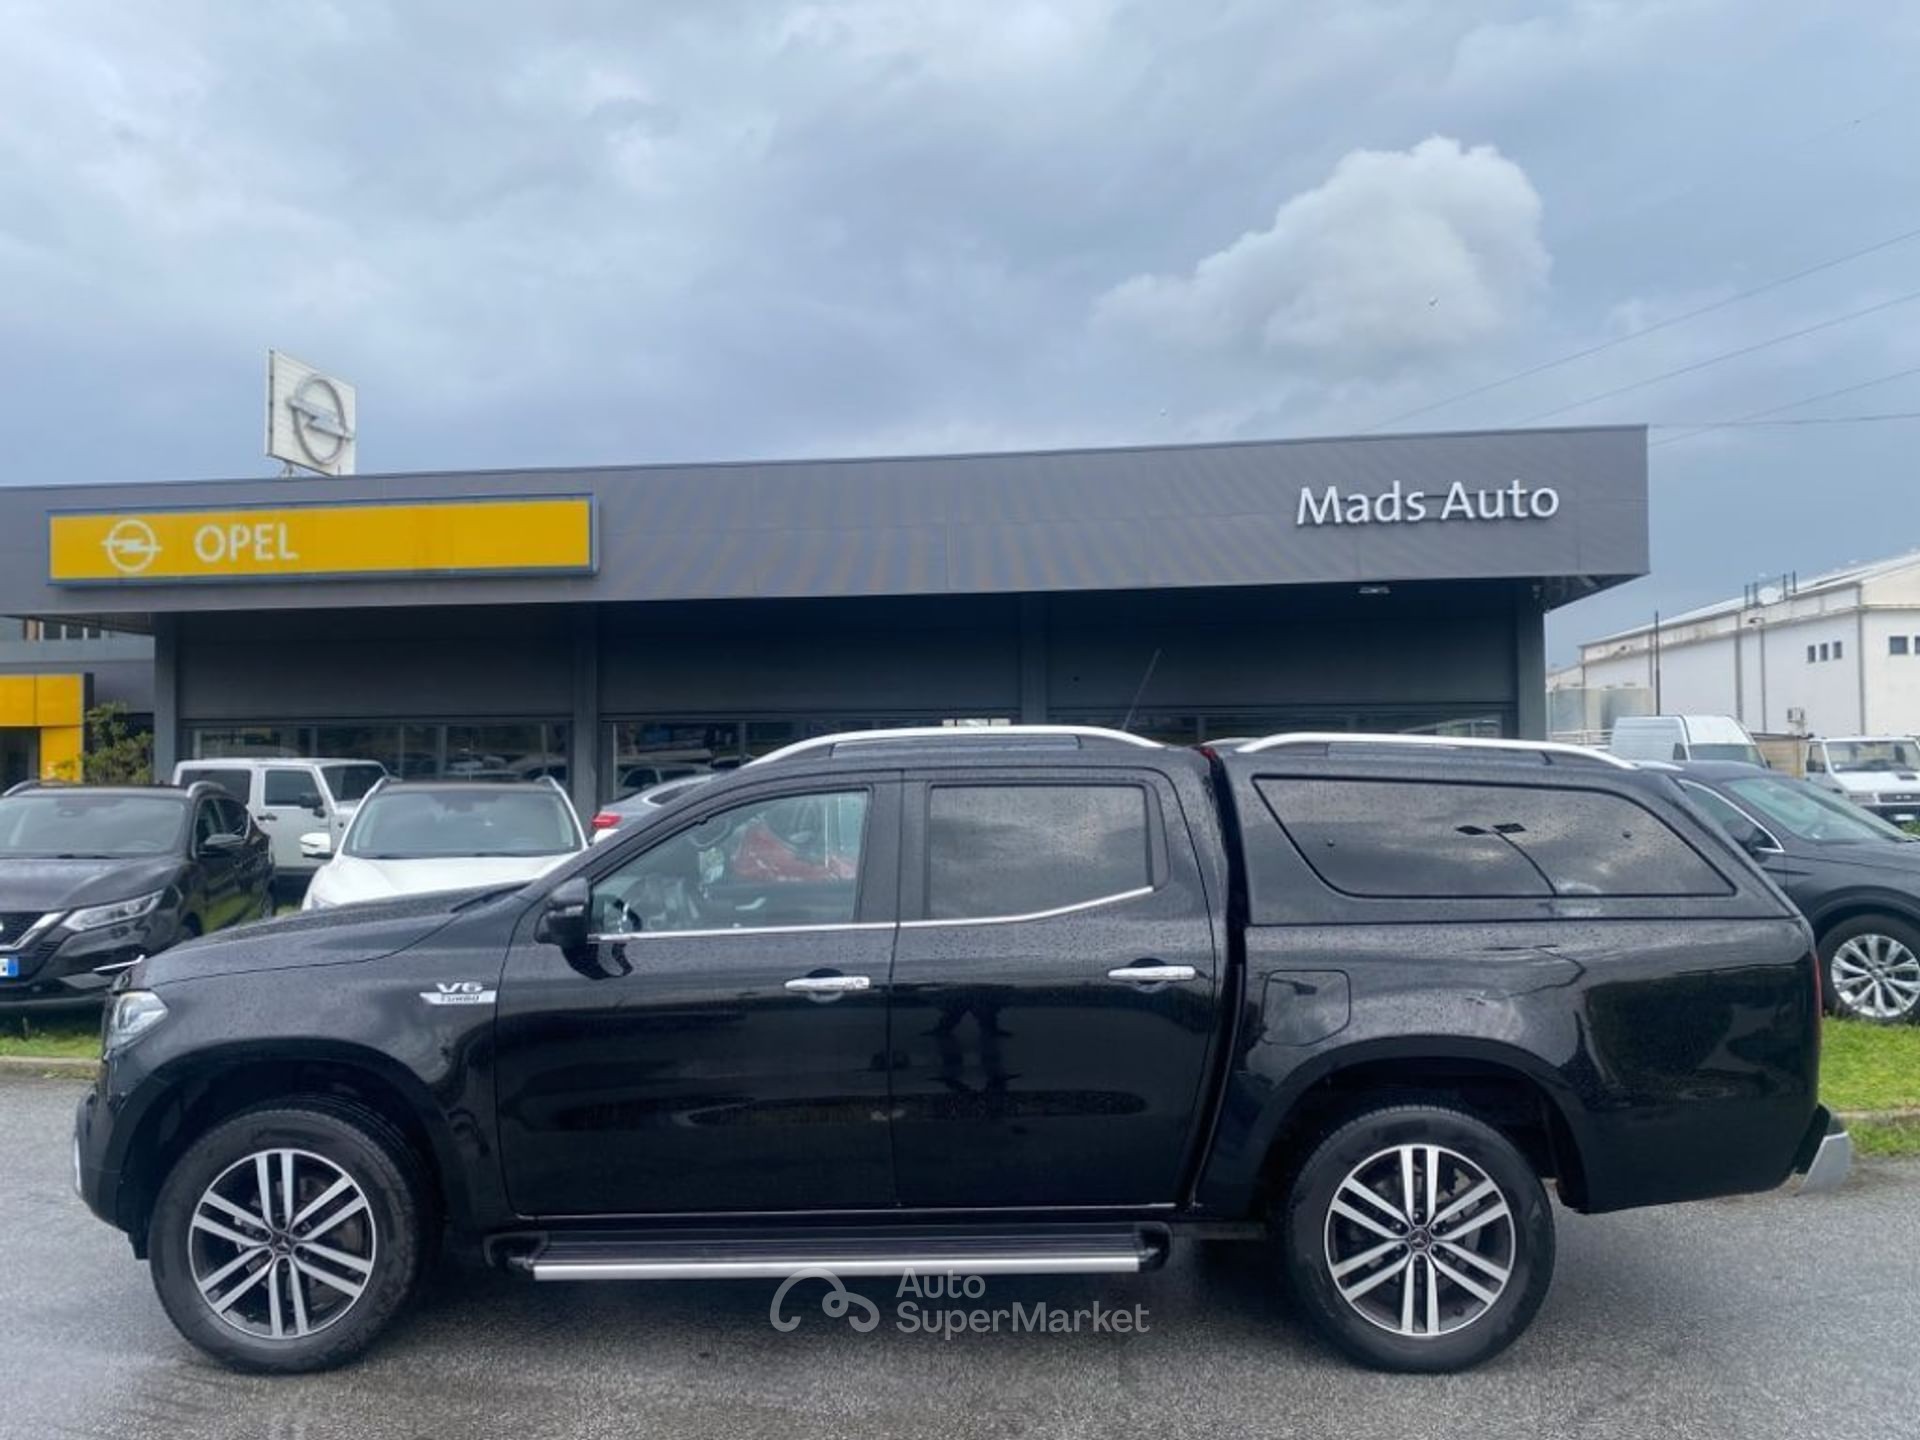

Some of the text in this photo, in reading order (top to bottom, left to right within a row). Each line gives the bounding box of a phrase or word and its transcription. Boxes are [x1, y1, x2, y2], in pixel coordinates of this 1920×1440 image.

[1297, 479, 1560, 524] Mads Auto
[194, 523, 298, 563] OPEL
[436, 982, 483, 993] V6
